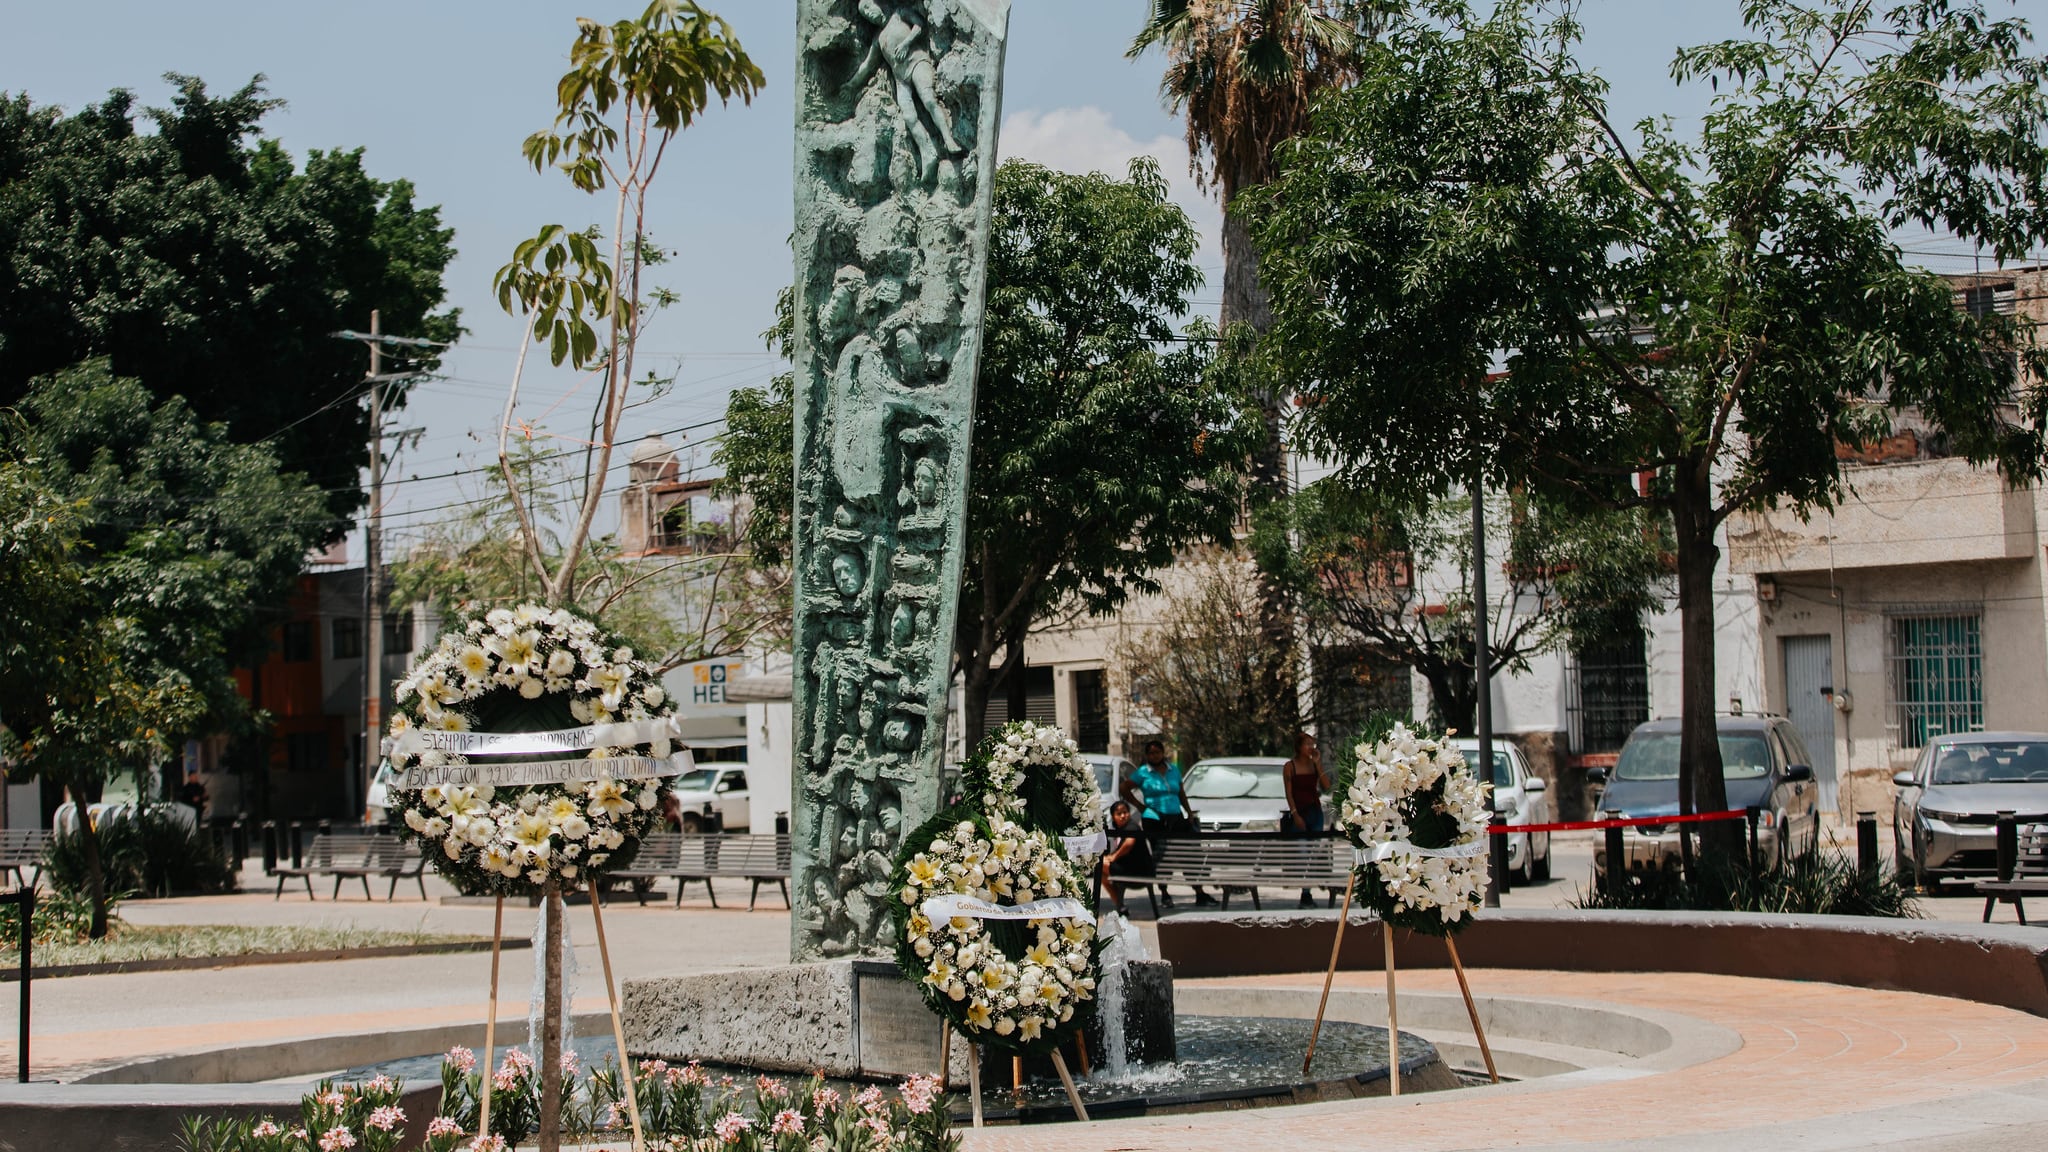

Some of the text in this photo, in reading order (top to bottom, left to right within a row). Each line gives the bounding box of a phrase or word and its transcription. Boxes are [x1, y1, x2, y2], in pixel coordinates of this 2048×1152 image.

[422, 733, 475, 751] SIEMPRE
[486, 766, 503, 784] 22
[505, 765, 518, 782] DE
[523, 762, 557, 784] ABRIL
[560, 762, 576, 779] EN
[956, 901, 992, 915] Gobierno
